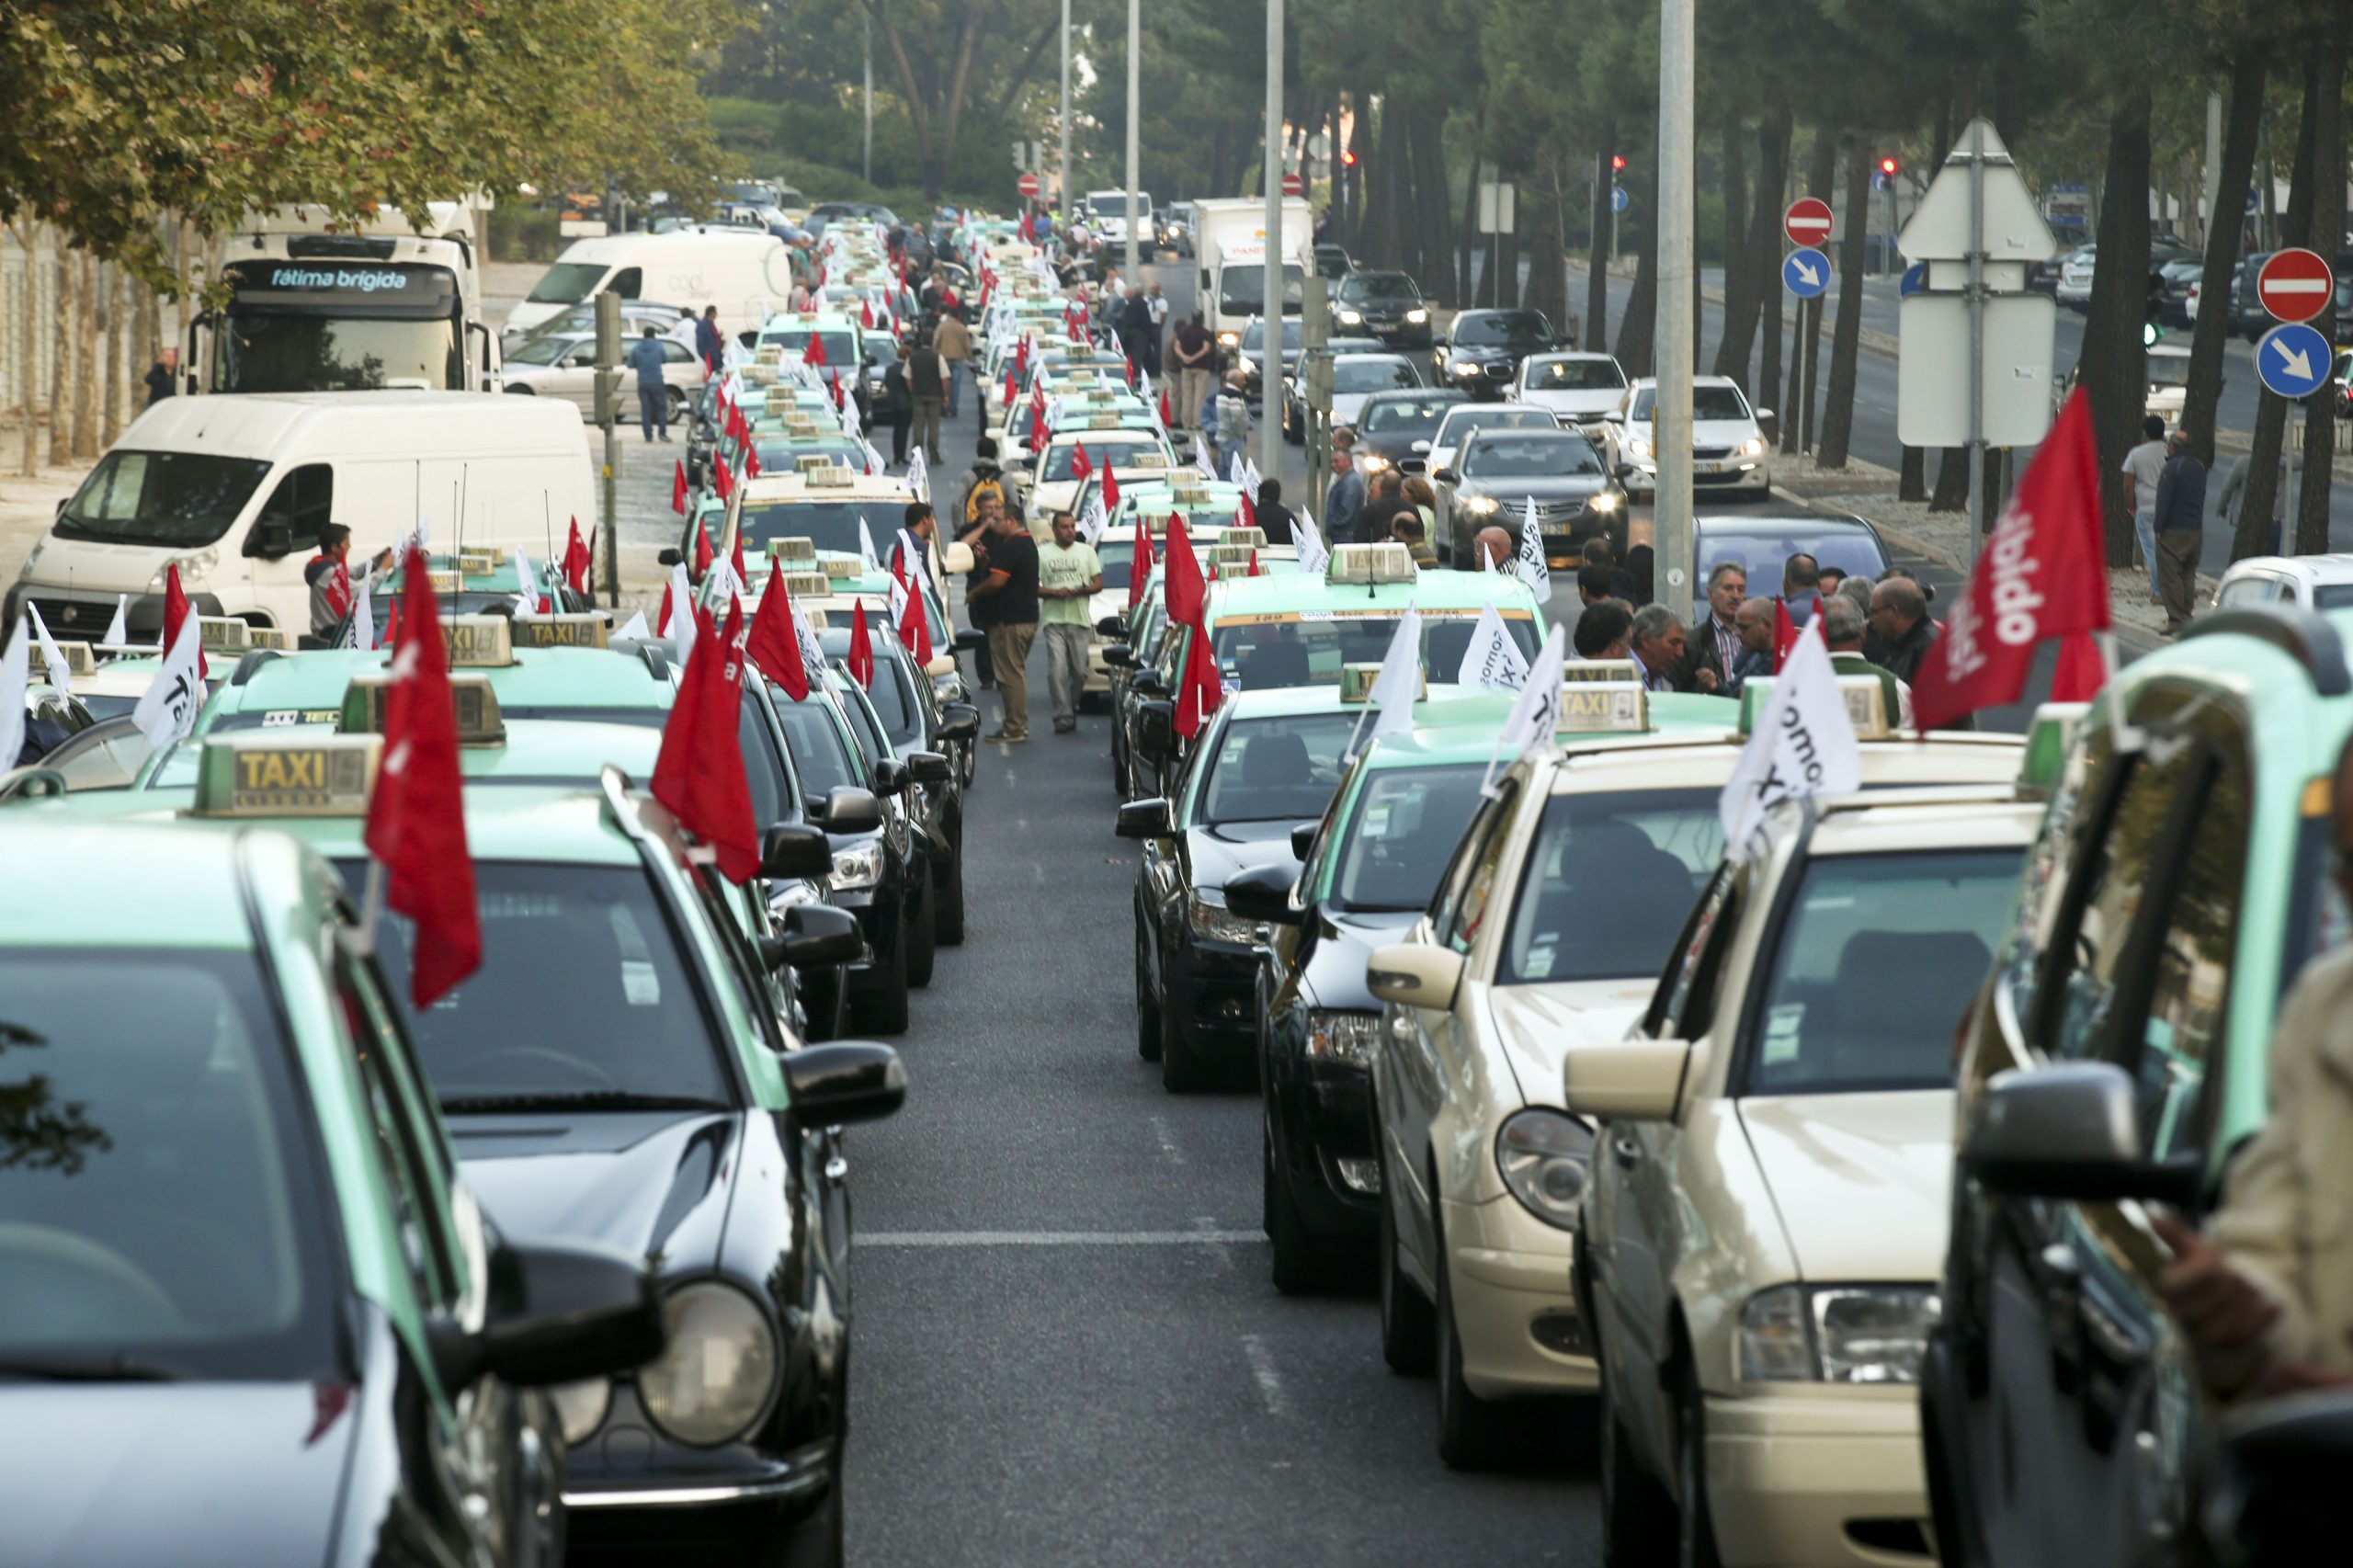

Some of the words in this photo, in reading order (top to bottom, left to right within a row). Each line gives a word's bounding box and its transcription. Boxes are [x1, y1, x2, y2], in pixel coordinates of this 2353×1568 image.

[336, 270, 407, 292] brigida
[202, 623, 226, 638] AXI
[530, 624, 575, 643] TAXI
[30, 648, 69, 663] TAI
[1563, 693, 1608, 716] TAXI
[240, 752, 324, 789] TAXI
